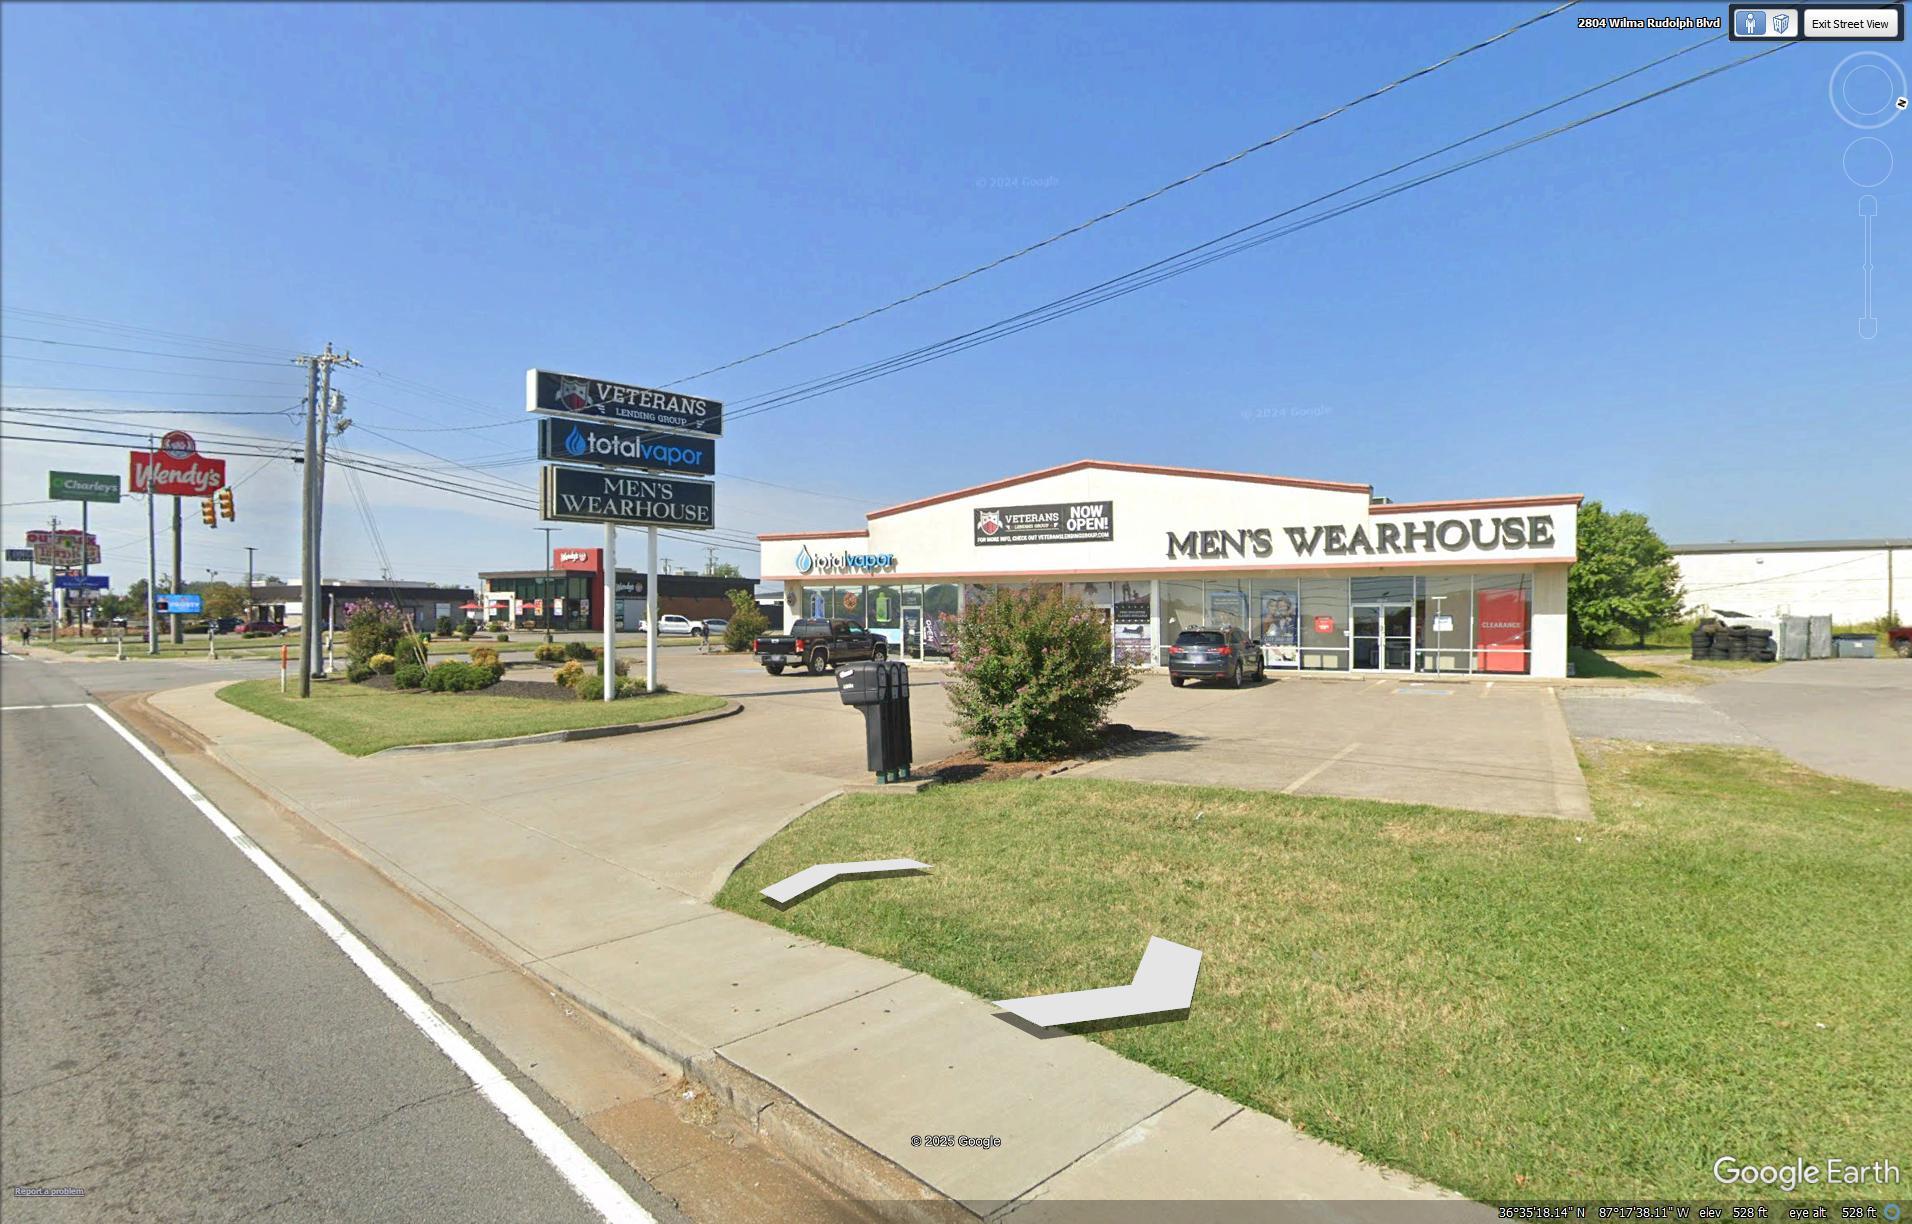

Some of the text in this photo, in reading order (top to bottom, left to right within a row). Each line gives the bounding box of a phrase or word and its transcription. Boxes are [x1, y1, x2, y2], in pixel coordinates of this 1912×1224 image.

[597, 383, 706, 416] VETERANS
[616, 407, 688, 426] LENDING GROUP
[63, 479, 118, 493] Charleys
[134, 462, 221, 491] Wendy's
[604, 478, 674, 500] MEN'S
[561, 494, 710, 522] WEARHOUSE
[1005, 513, 1059, 523] VETERANS
[1070, 505, 1103, 518] NOW
[1066, 517, 1109, 531] OPEN!
[1167, 514, 1555, 560] MEN'S WEARHOUSE
[925, 619, 934, 642] OPEN
[1481, 621, 1521, 629] CLEARANCE
